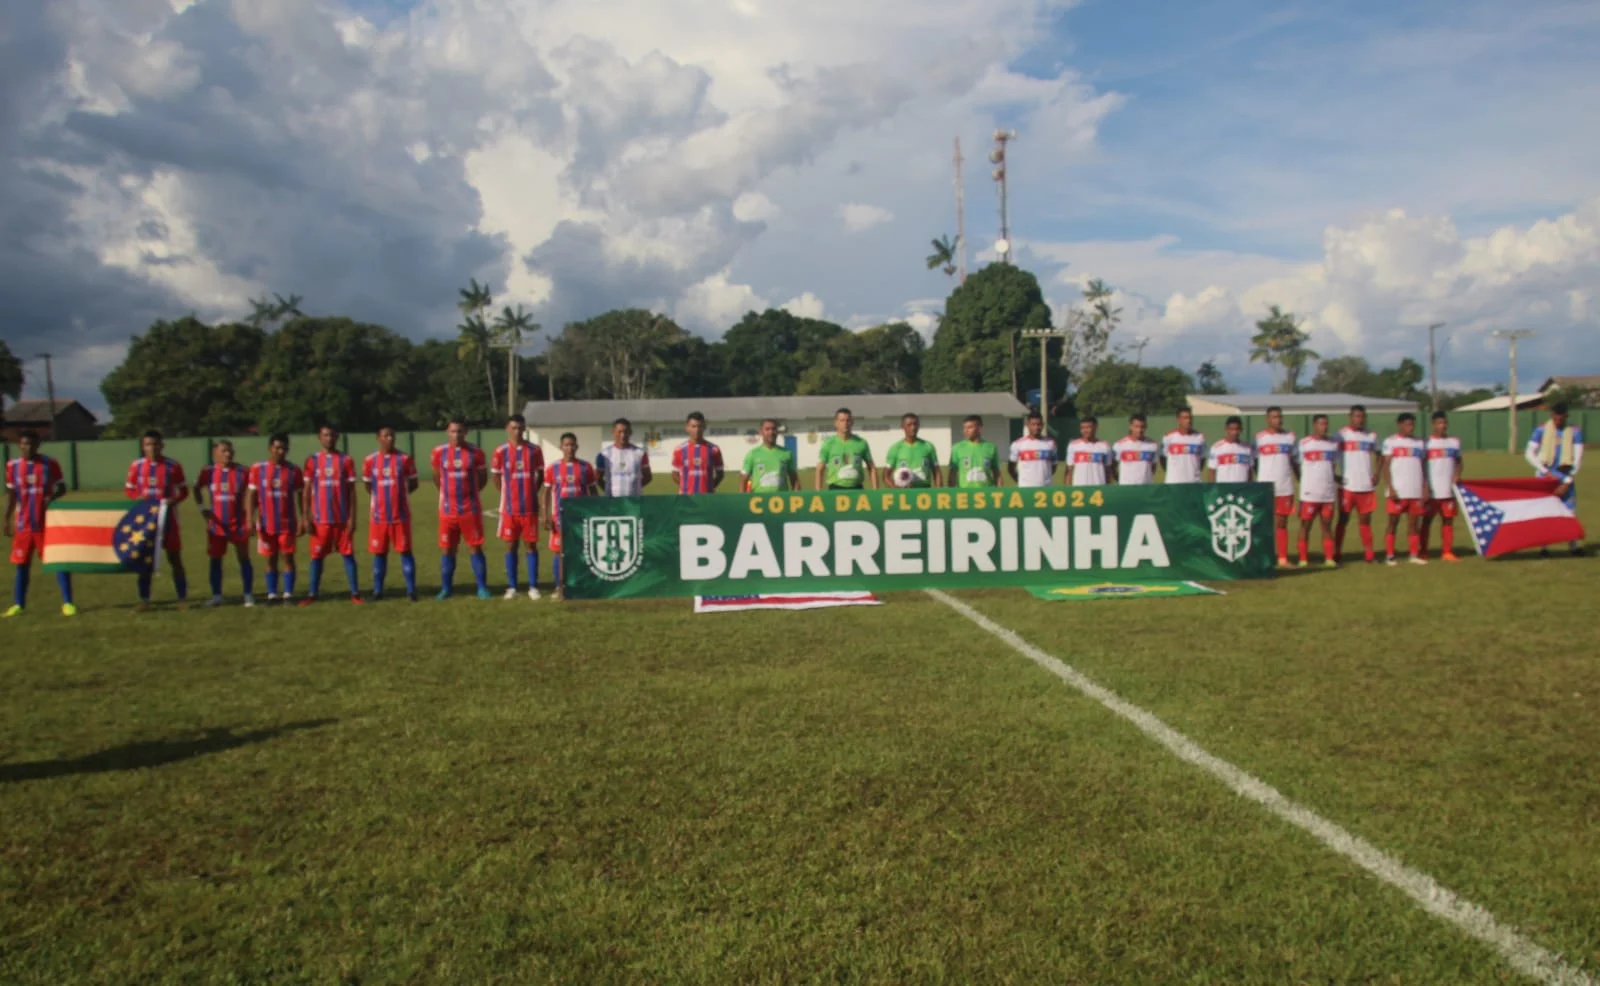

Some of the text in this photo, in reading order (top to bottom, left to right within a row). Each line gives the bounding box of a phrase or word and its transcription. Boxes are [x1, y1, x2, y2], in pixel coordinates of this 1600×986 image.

[749, 490, 1105, 514] COPA DA FLORESTA 2024
[679, 513, 1170, 581] BARREIRINHA
